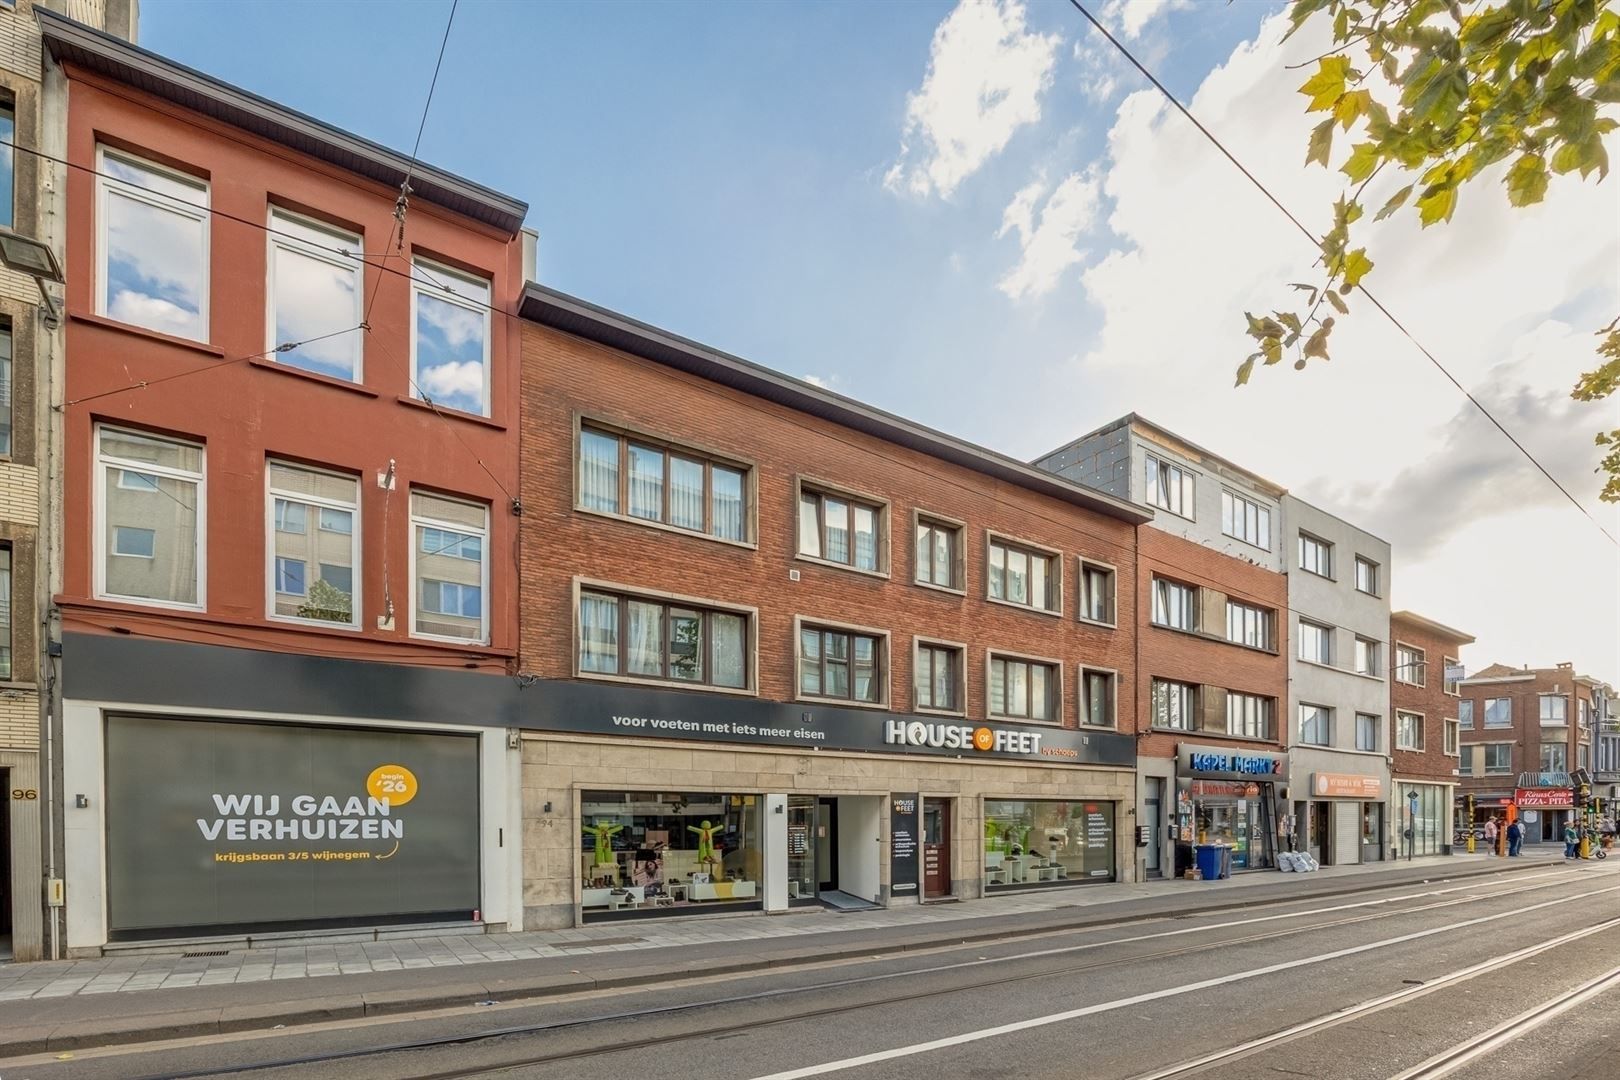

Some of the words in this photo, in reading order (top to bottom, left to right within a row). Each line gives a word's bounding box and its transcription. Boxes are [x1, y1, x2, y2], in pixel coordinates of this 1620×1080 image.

[612, 715, 648, 727] voor
[650, 718, 700, 731] voeten
[702, 721, 730, 734] met
[732, 722, 757, 735] iets
[759, 727, 791, 738] meer
[793, 727, 825, 740] eisen
[885, 720, 974, 750] HOUSE
[979, 734, 990, 743] OF
[993, 730, 1042, 754] FEET
[1272, 759, 1282, 775] 2
[381, 773, 404, 781] begin
[12, 789, 37, 800] 96
[212, 794, 280, 816] WIJ
[291, 795, 390, 816] GAAN
[196, 818, 404, 841] VERHUIZEN
[215, 852, 285, 863] krijgsbaan
[288, 851, 309, 861] 3/5
[312, 850, 370, 861] wijnegem
